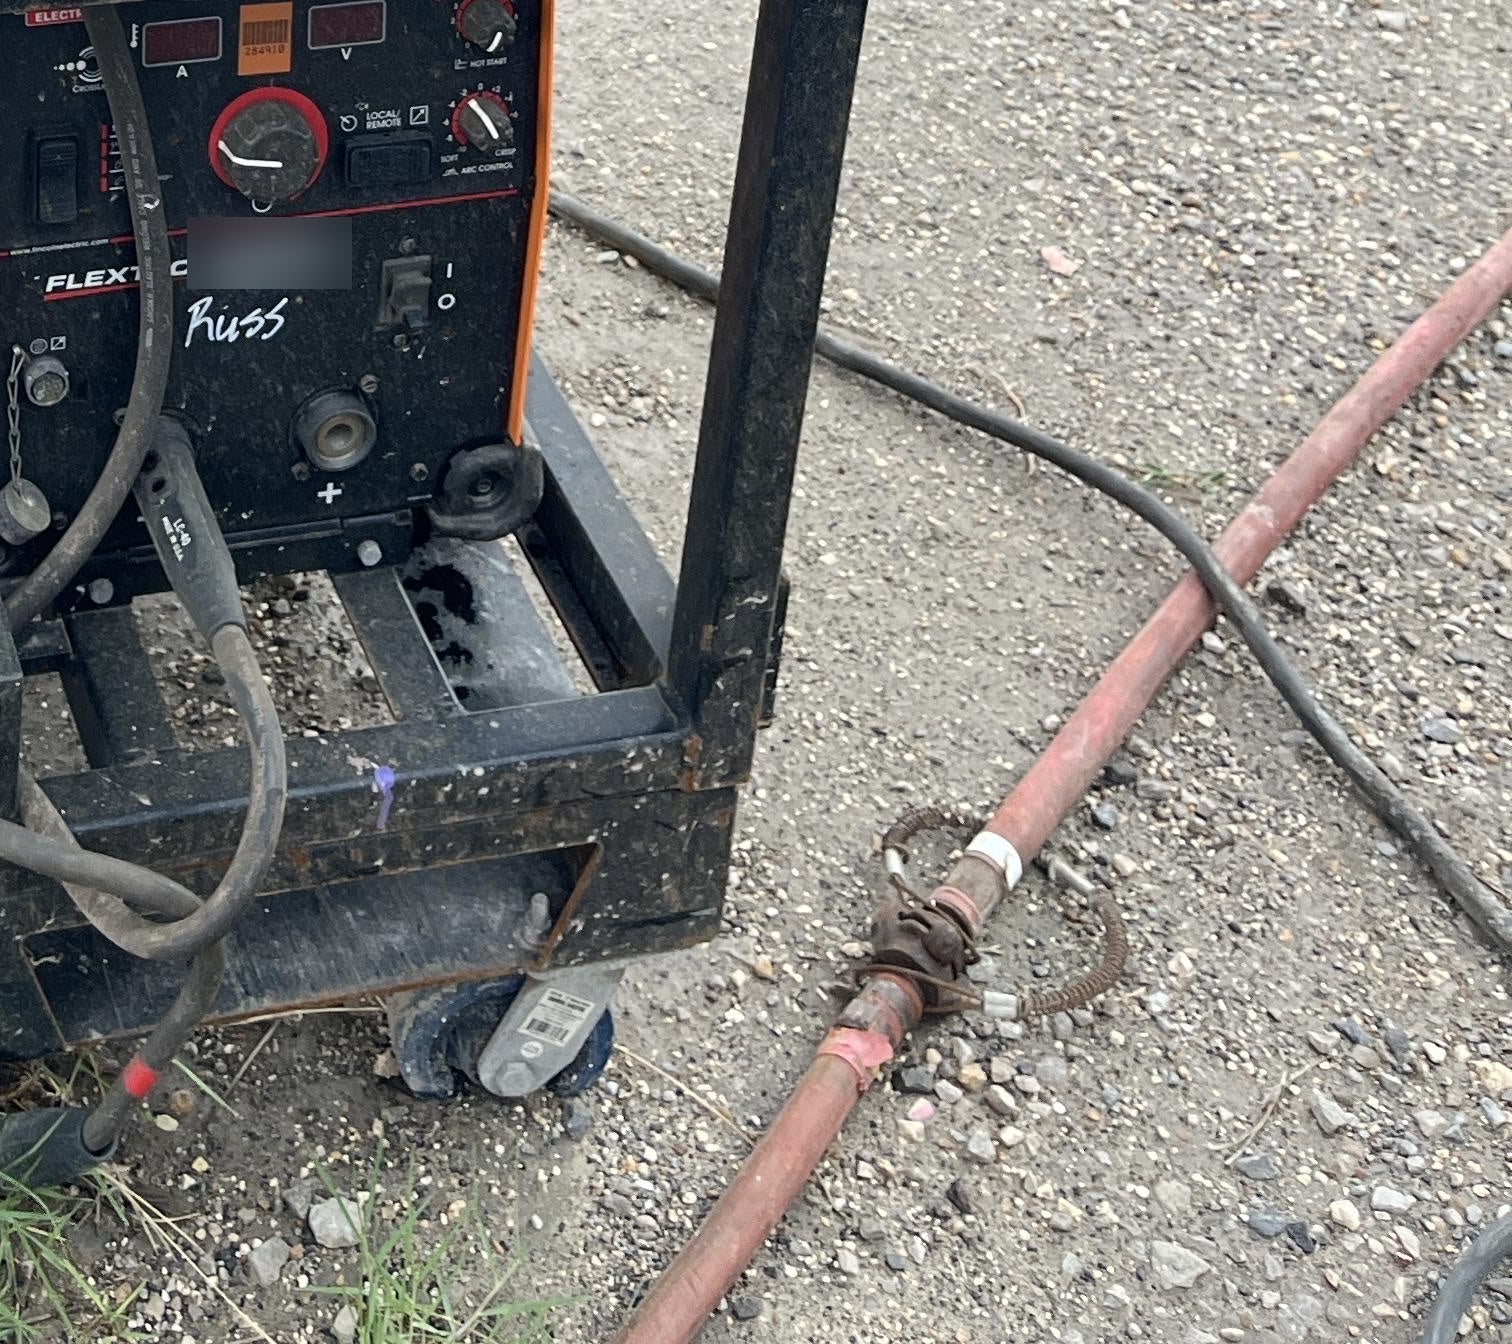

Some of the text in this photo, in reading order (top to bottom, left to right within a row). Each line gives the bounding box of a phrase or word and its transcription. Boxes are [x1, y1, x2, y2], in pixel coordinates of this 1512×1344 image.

[244, 44, 286, 56] 284910
[340, 48, 352, 60] V
[176, 65, 188, 78] A
[366, 110, 401, 120] LOCAL/
[366, 118, 402, 130] REMOTE
[461, 166, 477, 174] ARC
[45, 259, 188, 292] FLEXTC
[184, 296, 288, 348] Russ
